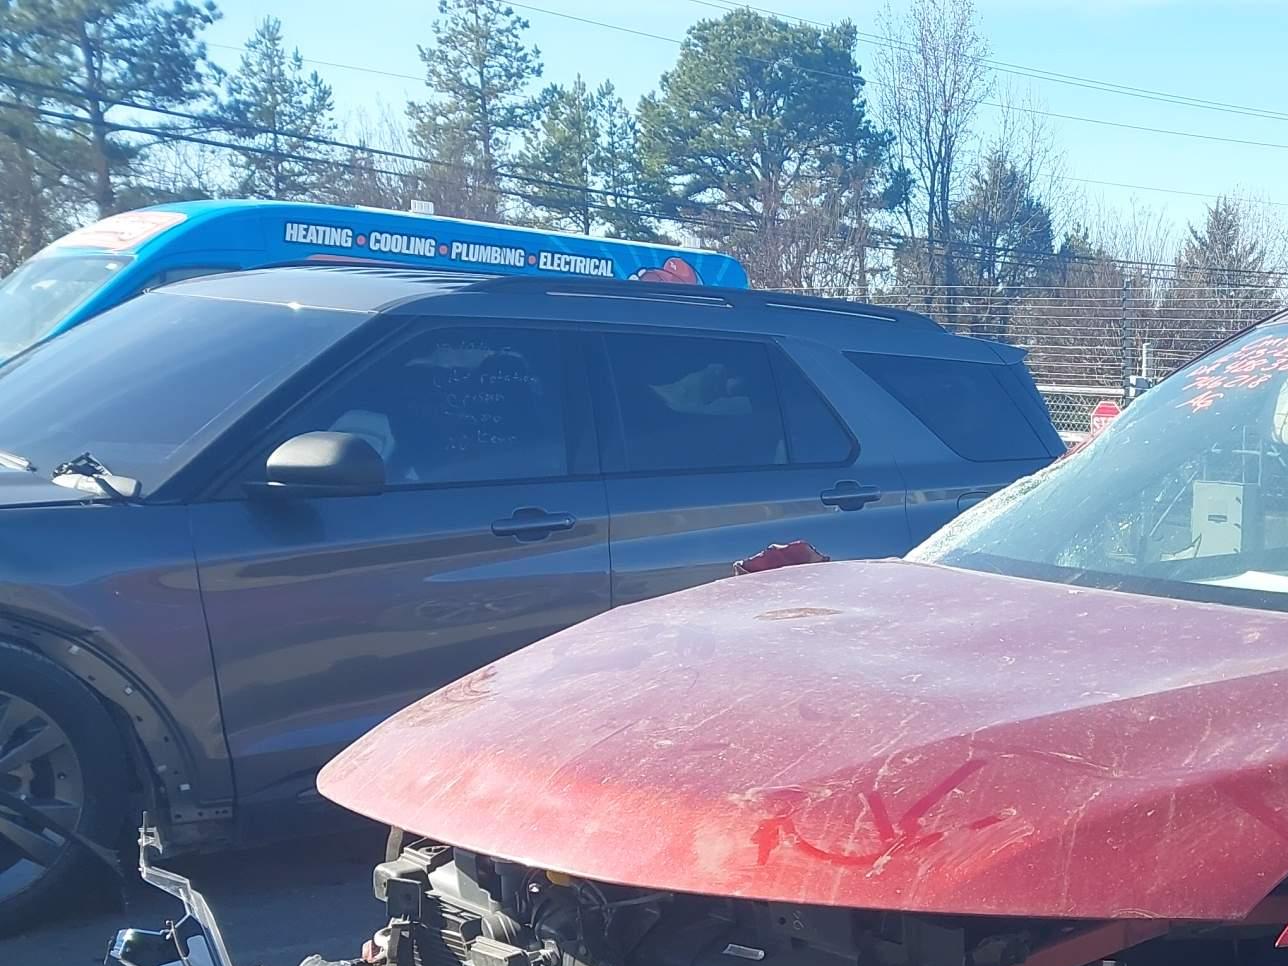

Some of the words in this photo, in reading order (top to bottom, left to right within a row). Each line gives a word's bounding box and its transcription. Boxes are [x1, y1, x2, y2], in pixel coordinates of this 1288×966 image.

[285, 222, 353, 248] HEATING
[369, 232, 436, 257] COOLING
[451, 242, 525, 267] PLUMBING
[539, 252, 614, 277] ELECTRICAL
